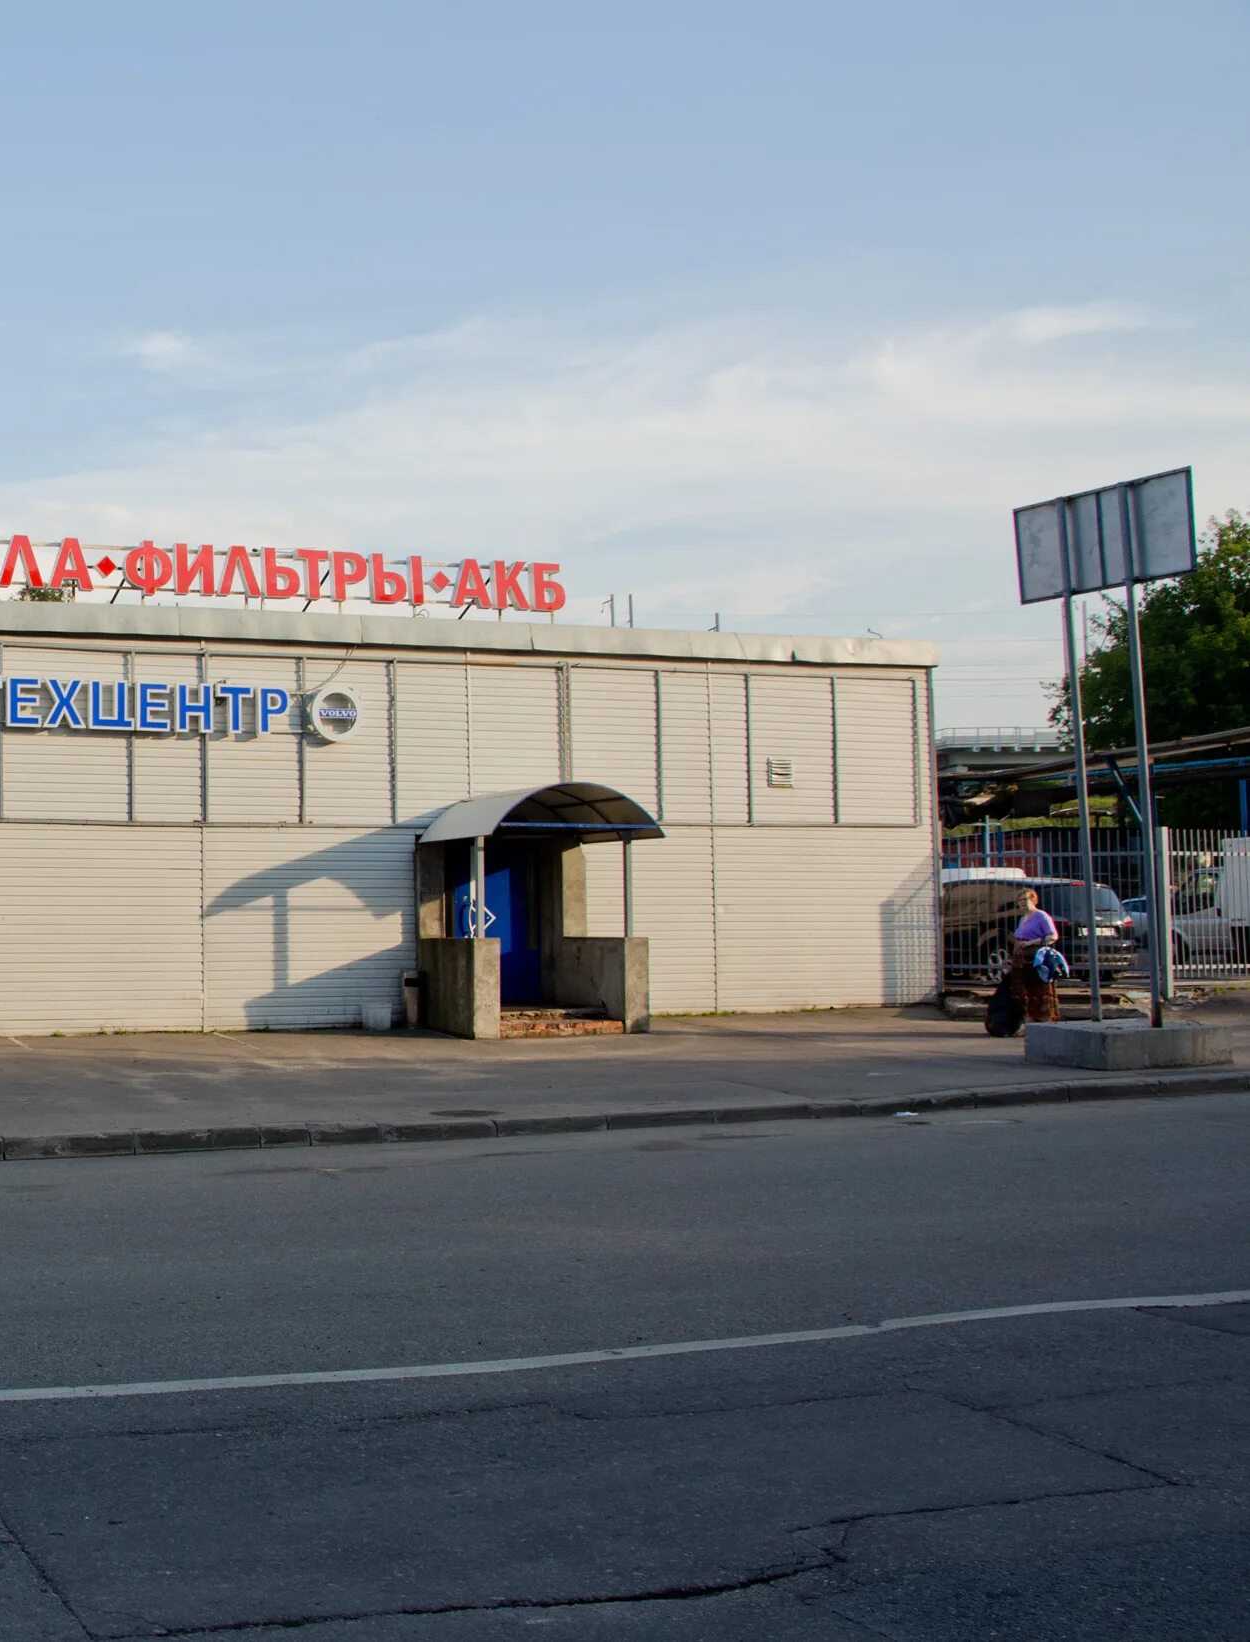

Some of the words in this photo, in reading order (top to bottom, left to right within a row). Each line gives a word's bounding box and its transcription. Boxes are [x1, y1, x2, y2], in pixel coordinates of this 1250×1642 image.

[123, 539, 425, 606] ФИЛЬТРЫ
[450, 558, 566, 612] АКБ
[320, 709, 356, 717] VOLVO
